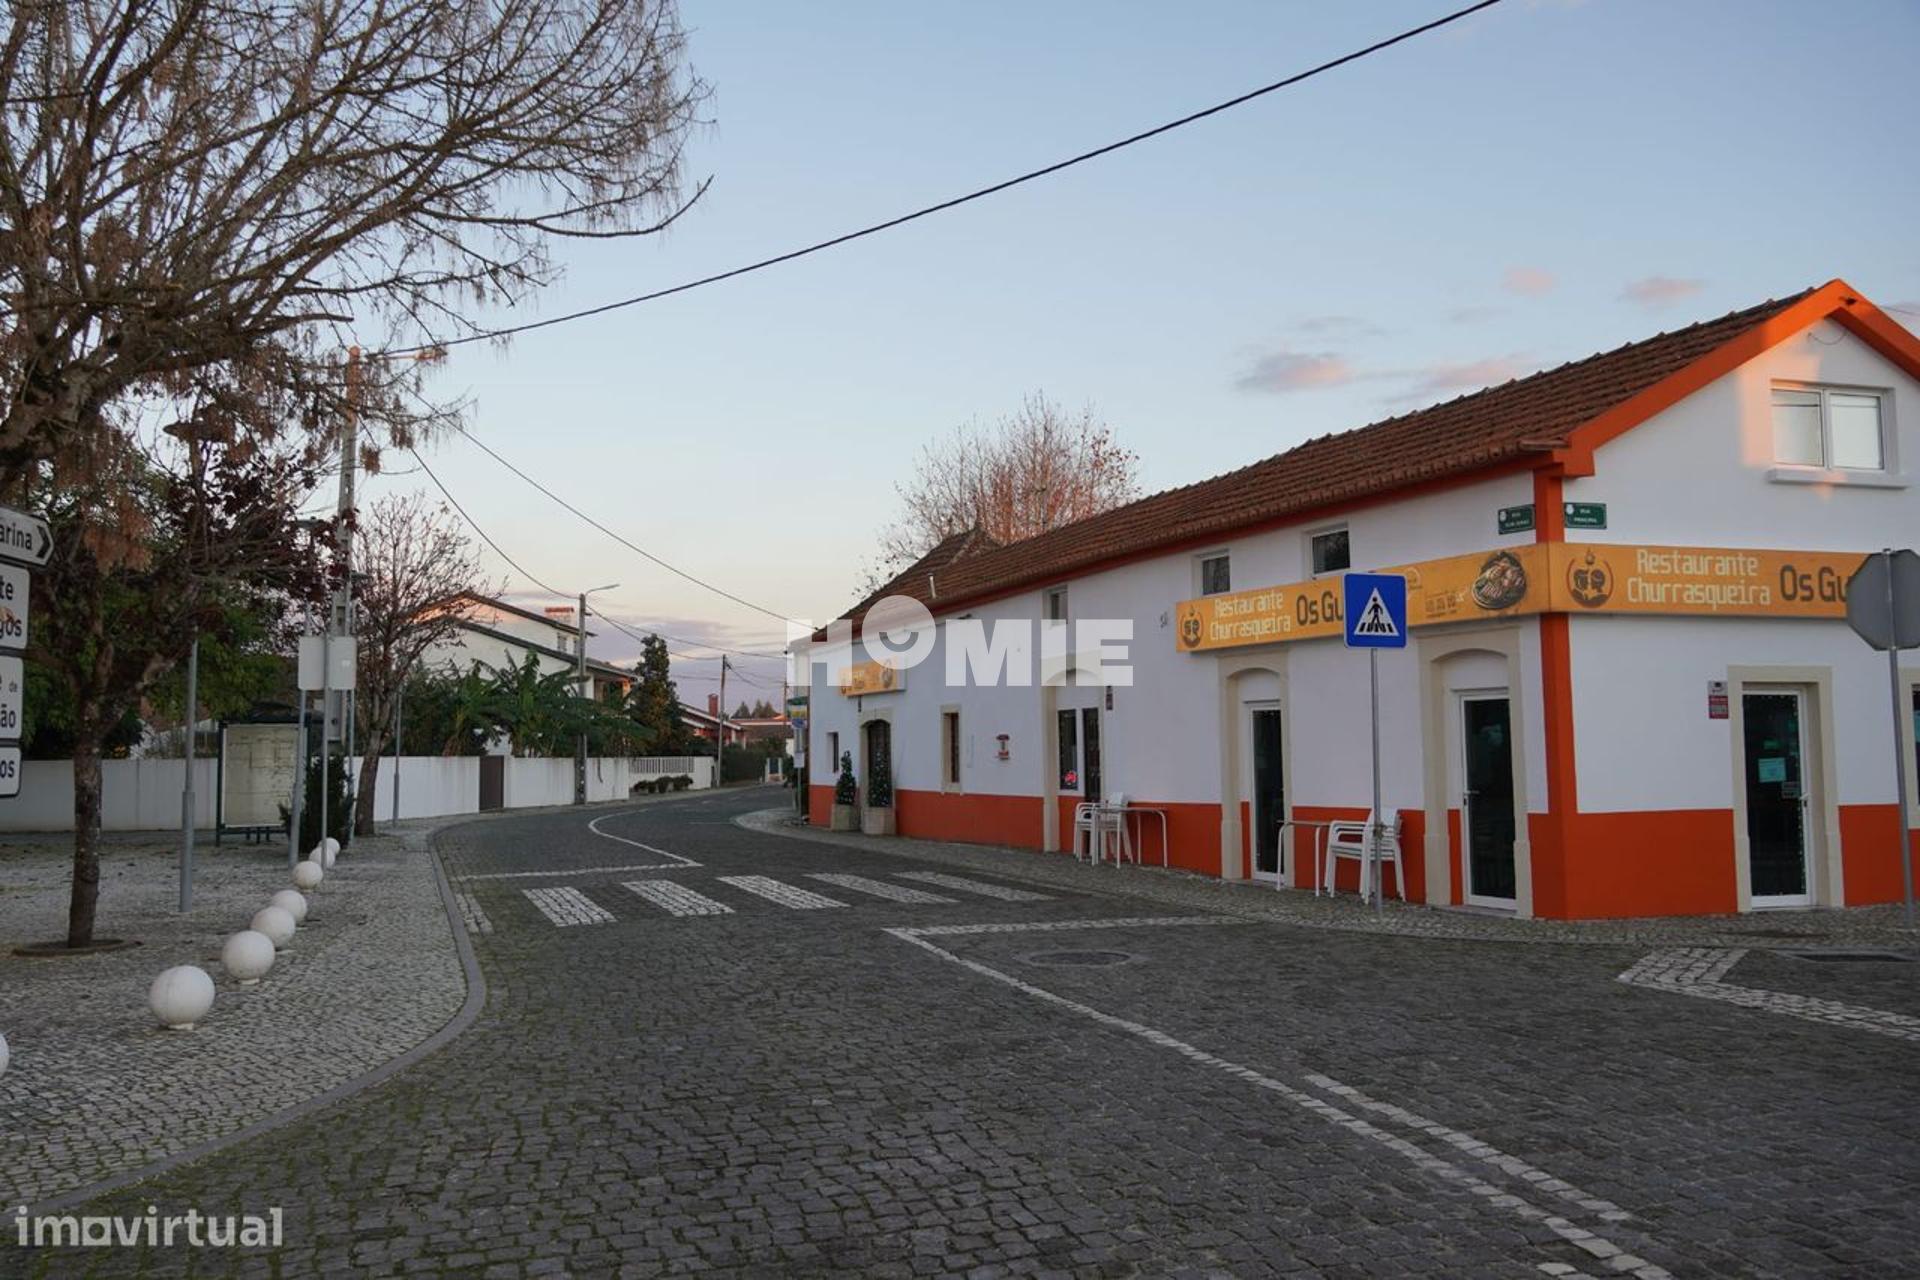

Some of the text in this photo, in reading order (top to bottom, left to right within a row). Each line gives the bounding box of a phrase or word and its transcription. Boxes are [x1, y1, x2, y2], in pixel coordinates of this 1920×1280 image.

[1636, 548, 1759, 576] Restaurante
[1627, 575, 1771, 611] Churrasqueira
[1780, 564, 1814, 602] Os
[1215, 590, 1284, 618] Restaurante
[1296, 594, 1319, 627] Os
[1210, 613, 1291, 641] Churrasqueira
